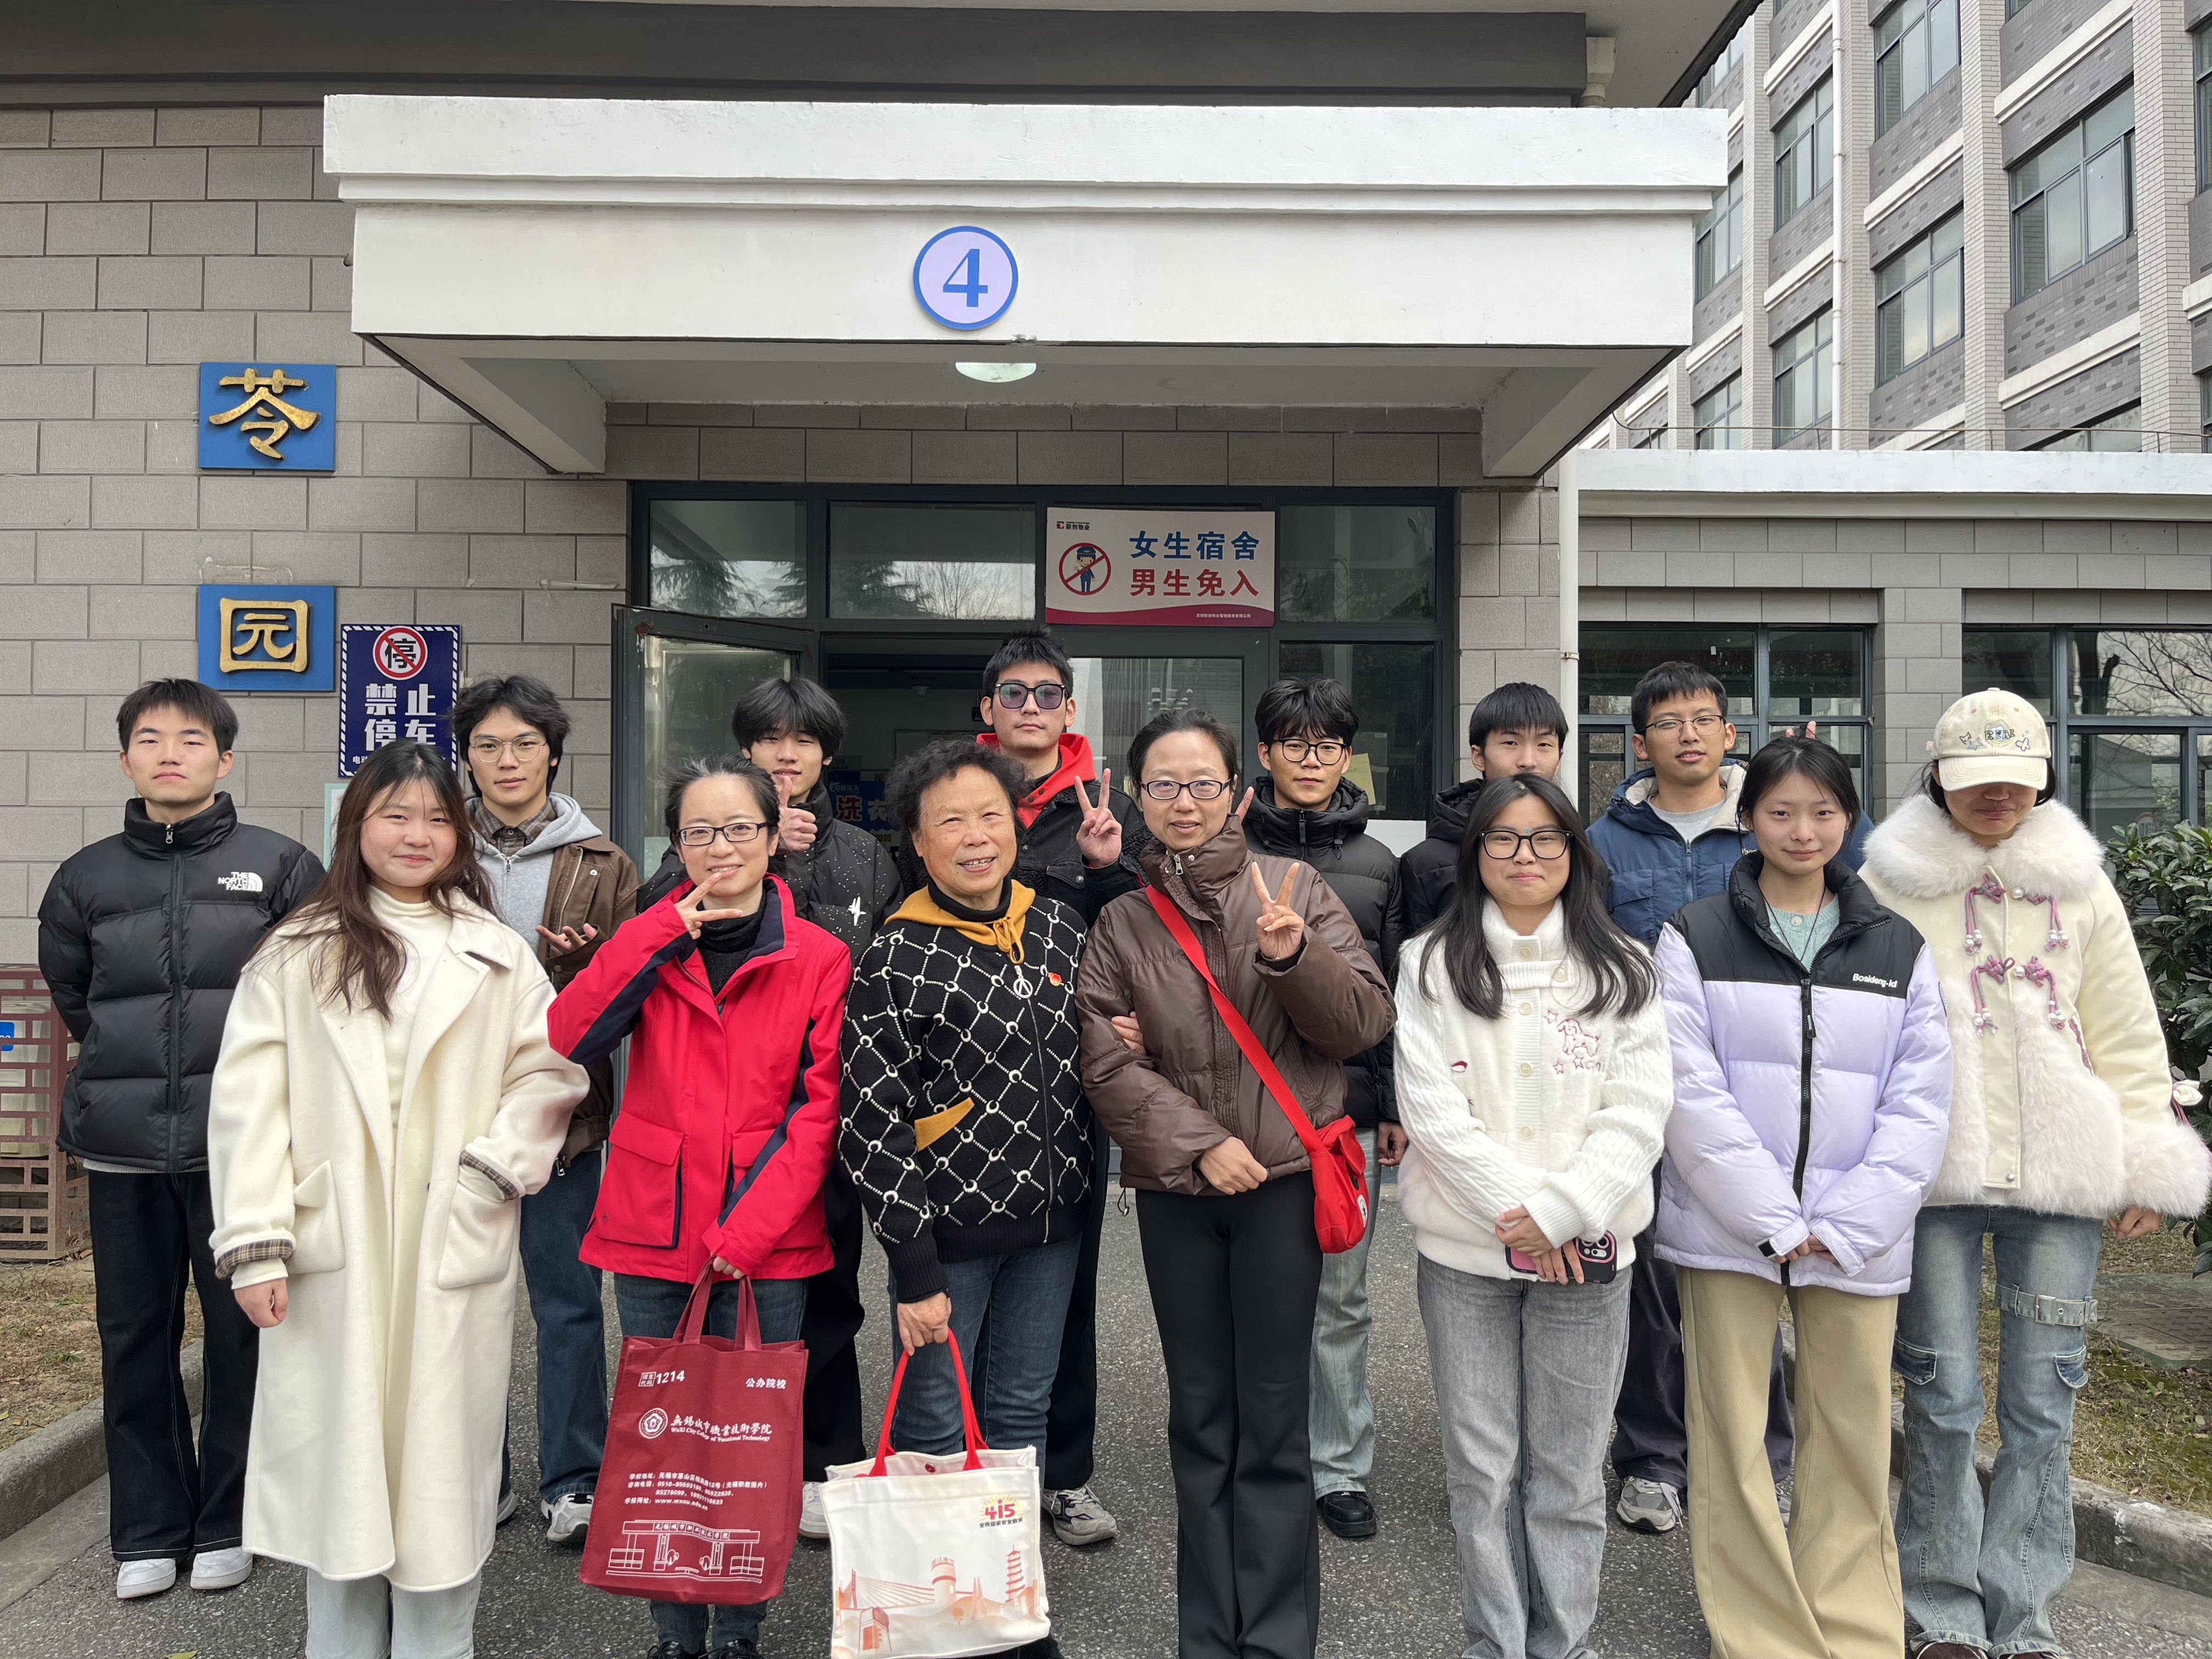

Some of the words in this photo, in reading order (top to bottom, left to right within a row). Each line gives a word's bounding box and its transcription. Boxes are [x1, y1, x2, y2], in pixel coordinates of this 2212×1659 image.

[943, 249, 988, 307] 4
[208, 368, 321, 461] 苓
[1129, 531, 1260, 560] 女生宿舍
[1129, 568, 1260, 597] 男生免入
[219, 597, 311, 673] 园
[384, 637, 416, 669] 停
[365, 683, 437, 716] 禁止
[364, 719, 437, 752] 停车
[1984, 729, 2016, 741] REAL
[836, 795, 887, 822] 洗衣
[217, 877, 249, 885] NORTH
[1852, 973, 1898, 988] Bosideng-id
[656, 1370, 685, 1385] 1214
[745, 1377, 787, 1390] 公办院校
